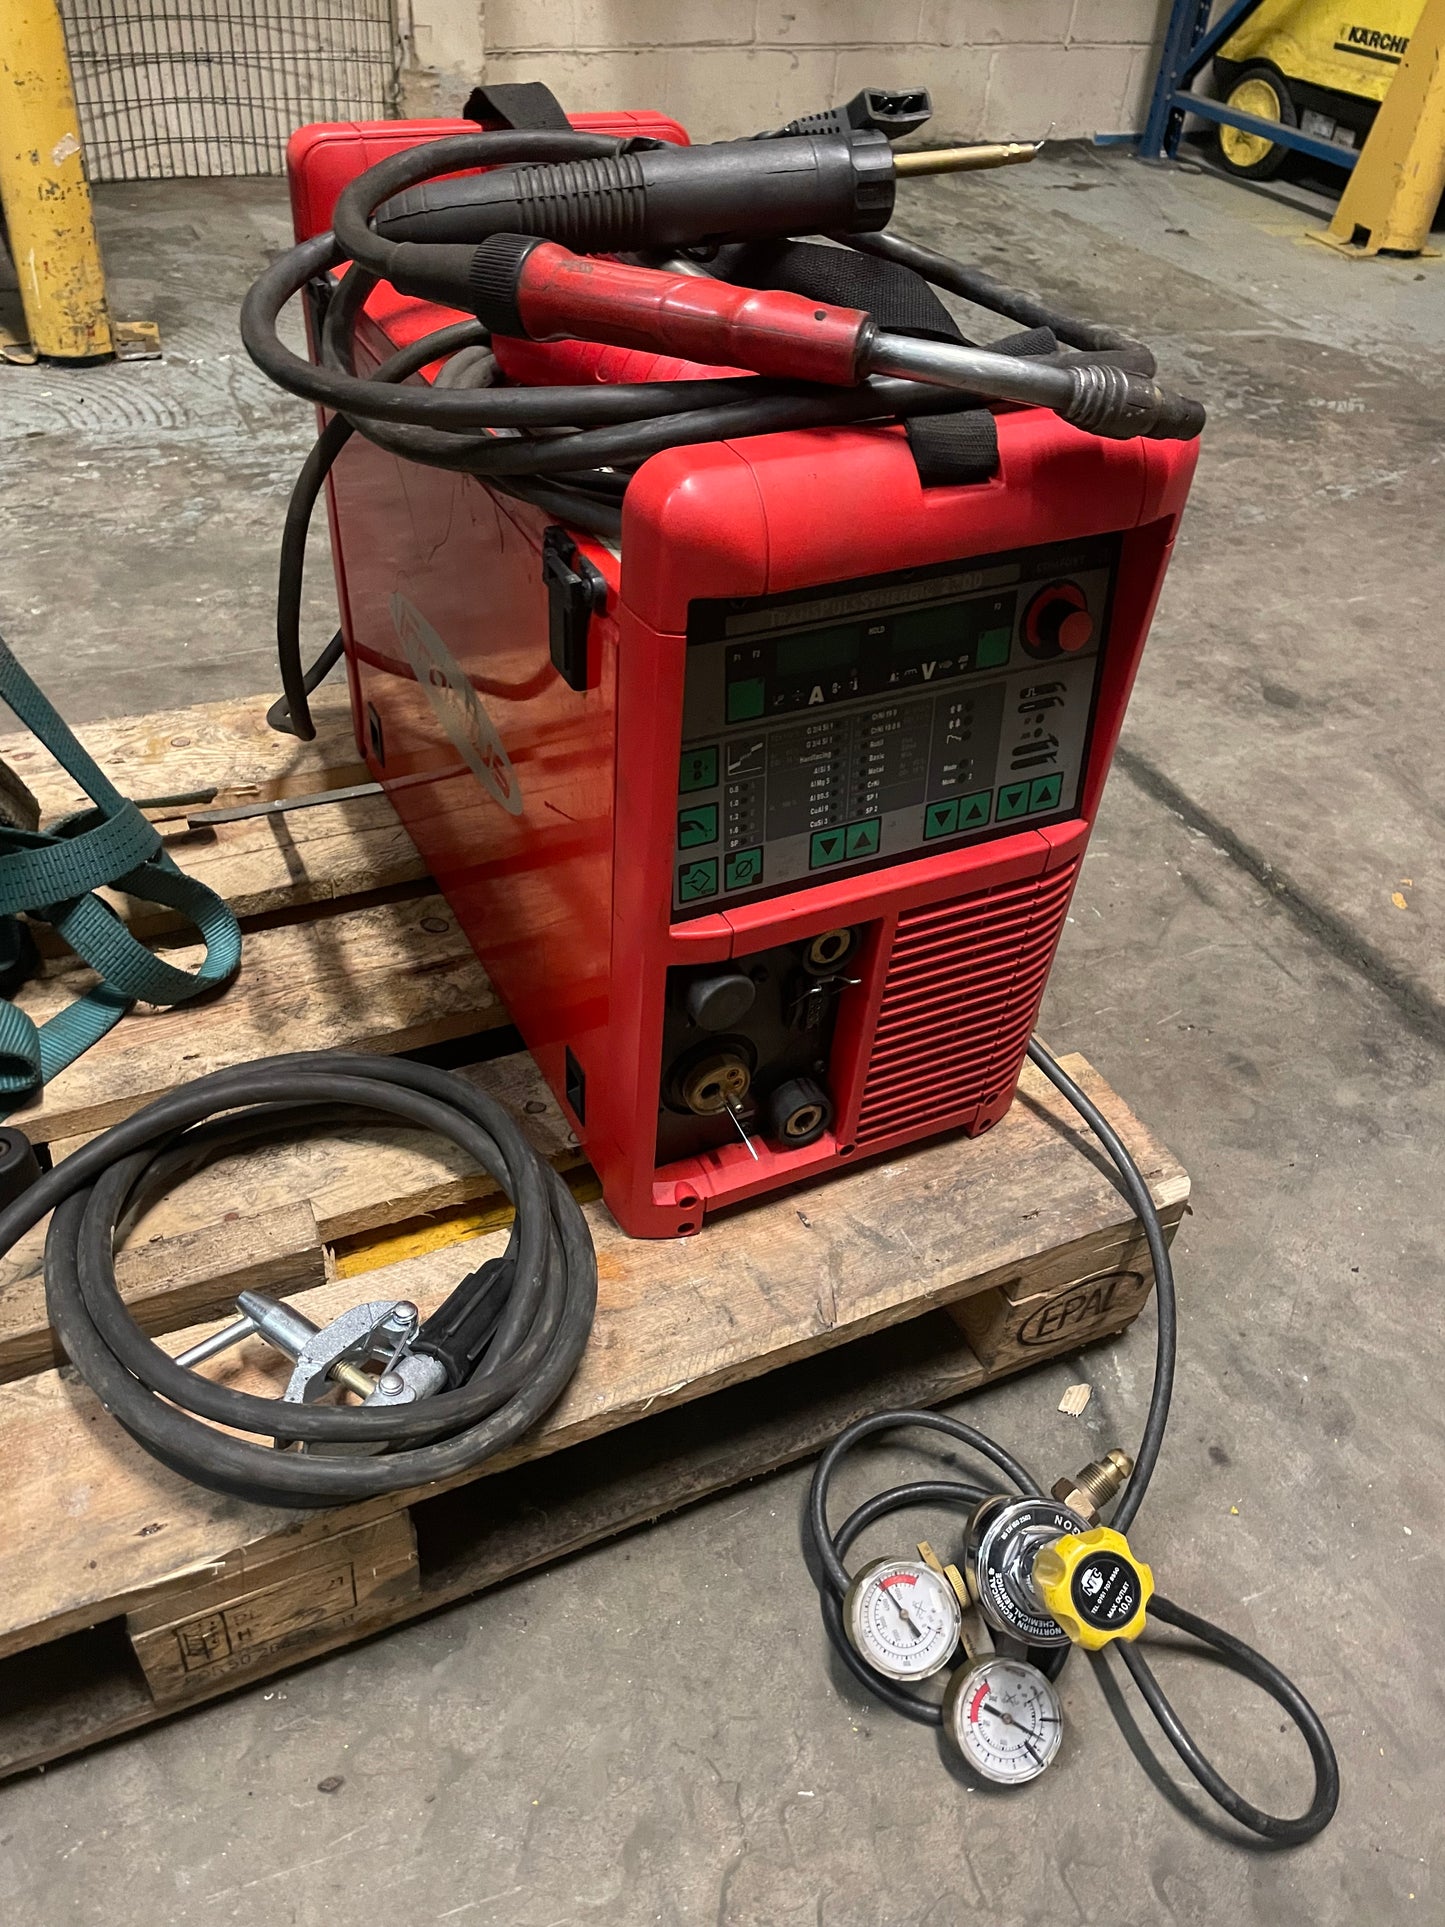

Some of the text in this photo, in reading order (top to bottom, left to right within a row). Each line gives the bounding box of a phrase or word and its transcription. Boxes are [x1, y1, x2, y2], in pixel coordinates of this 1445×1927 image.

[920, 660, 936, 681] V
[808, 685, 826, 705] A
[868, 753, 885, 762] Basic
[866, 794, 875, 802] SP
[729, 839, 739, 848] SP
[1035, 1281, 1118, 1337] EPAL
[1054, 1514, 1082, 1536] GON
[989, 1576, 1016, 1624] TECHNICAL
[995, 1572, 1016, 1610] SERVICE
[1106, 1581, 1130, 1619] MAX OUTLET
[1090, 1603, 1100, 1614] TEL
[1118, 1595, 1133, 1615] 10.0
[1014, 1607, 1055, 1628] CHEMICAL
[1016, 1621, 1062, 1636] NORTHERN
